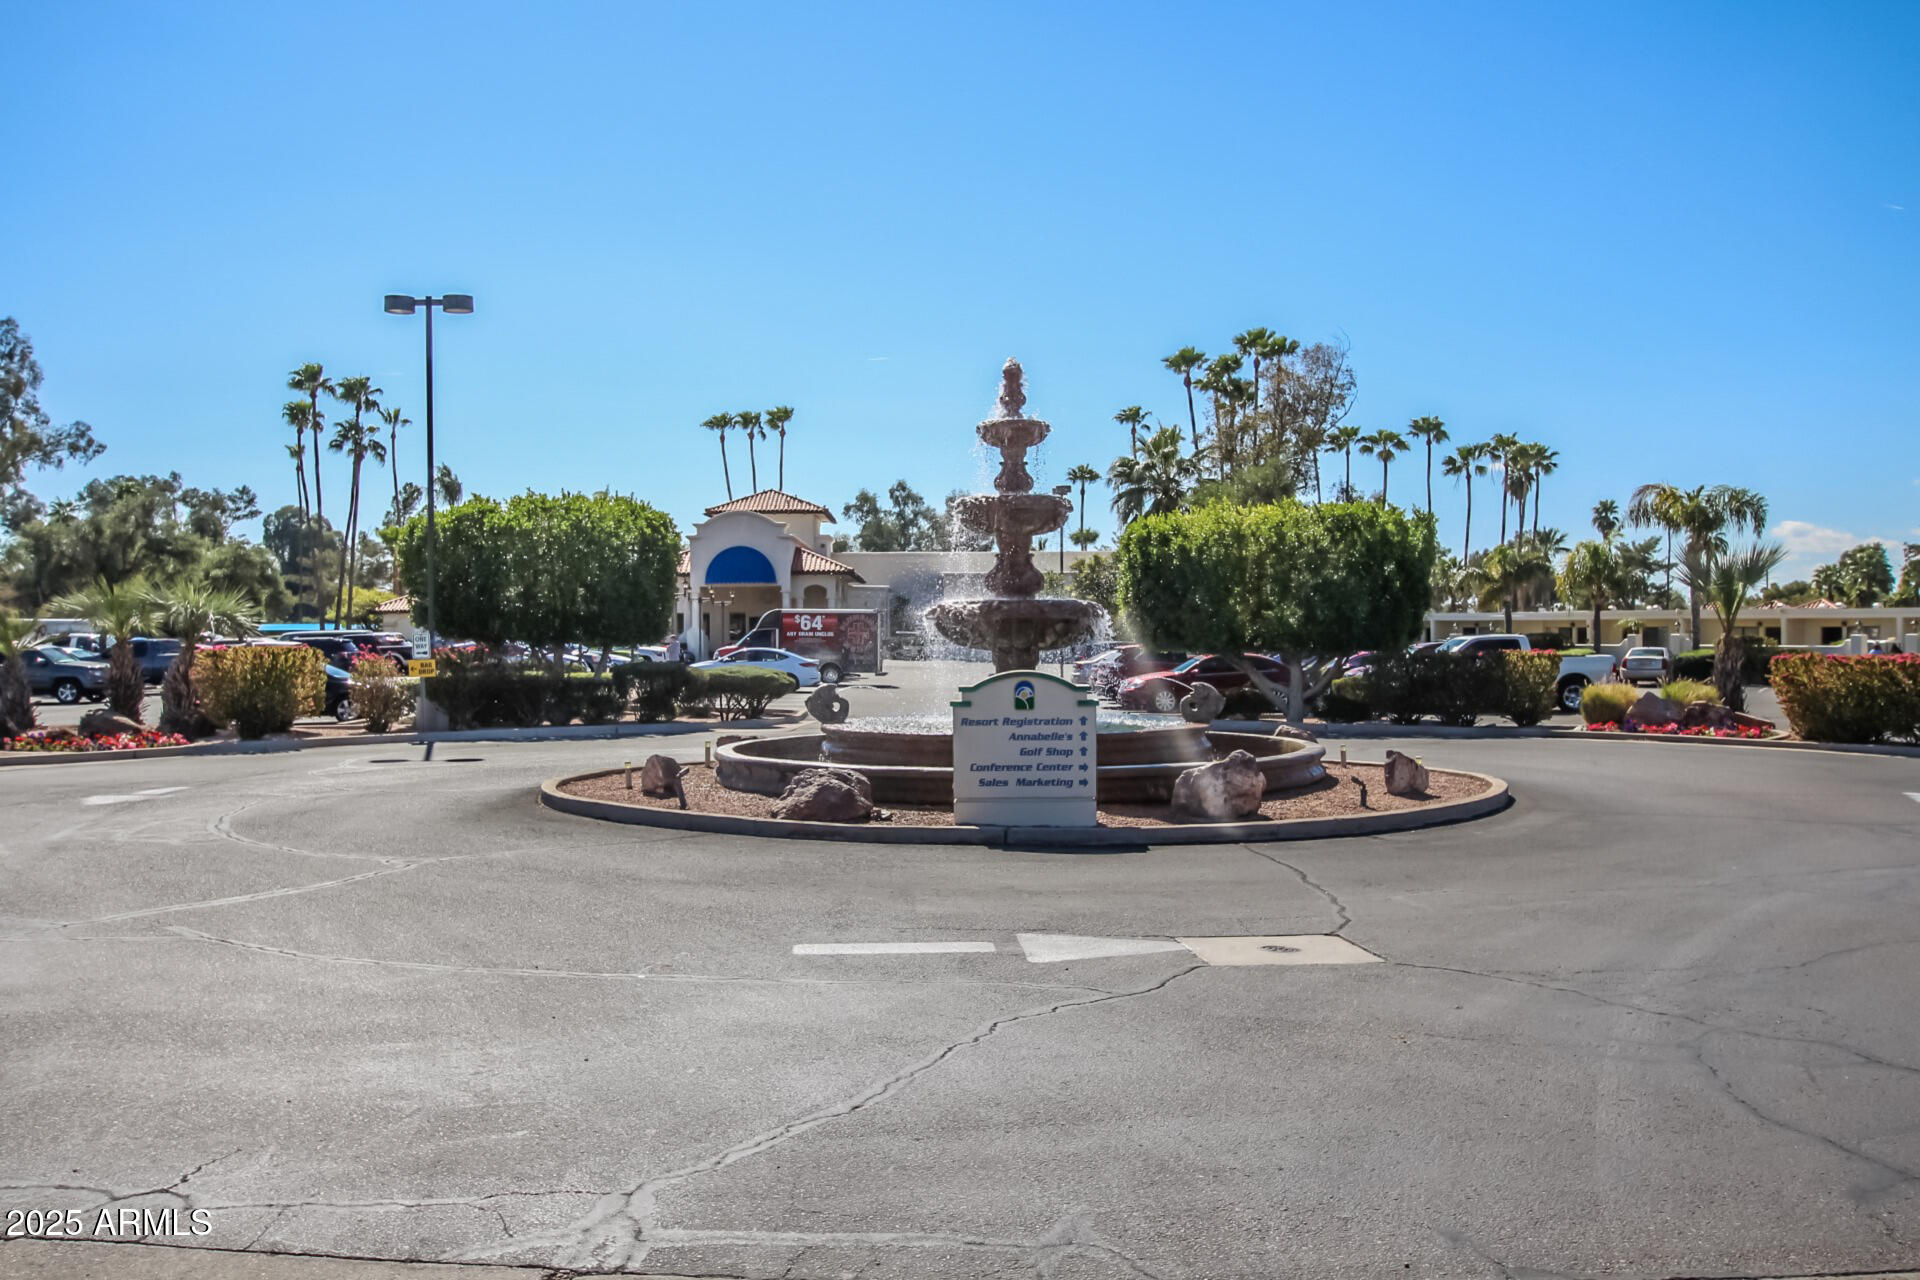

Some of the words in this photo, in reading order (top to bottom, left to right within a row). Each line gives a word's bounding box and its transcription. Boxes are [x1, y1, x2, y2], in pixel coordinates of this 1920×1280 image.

[960, 717, 999, 727] Resort
[1002, 717, 1073, 728] Registration
[1009, 732, 1073, 741] Annabelle's
[1019, 747, 1043, 757] Golf
[1045, 747, 1073, 758] Shop
[970, 763, 1033, 772] Conference
[1036, 763, 1073, 772] Center
[978, 778, 1009, 787] Sales
[1016, 778, 1073, 788] Marketing
